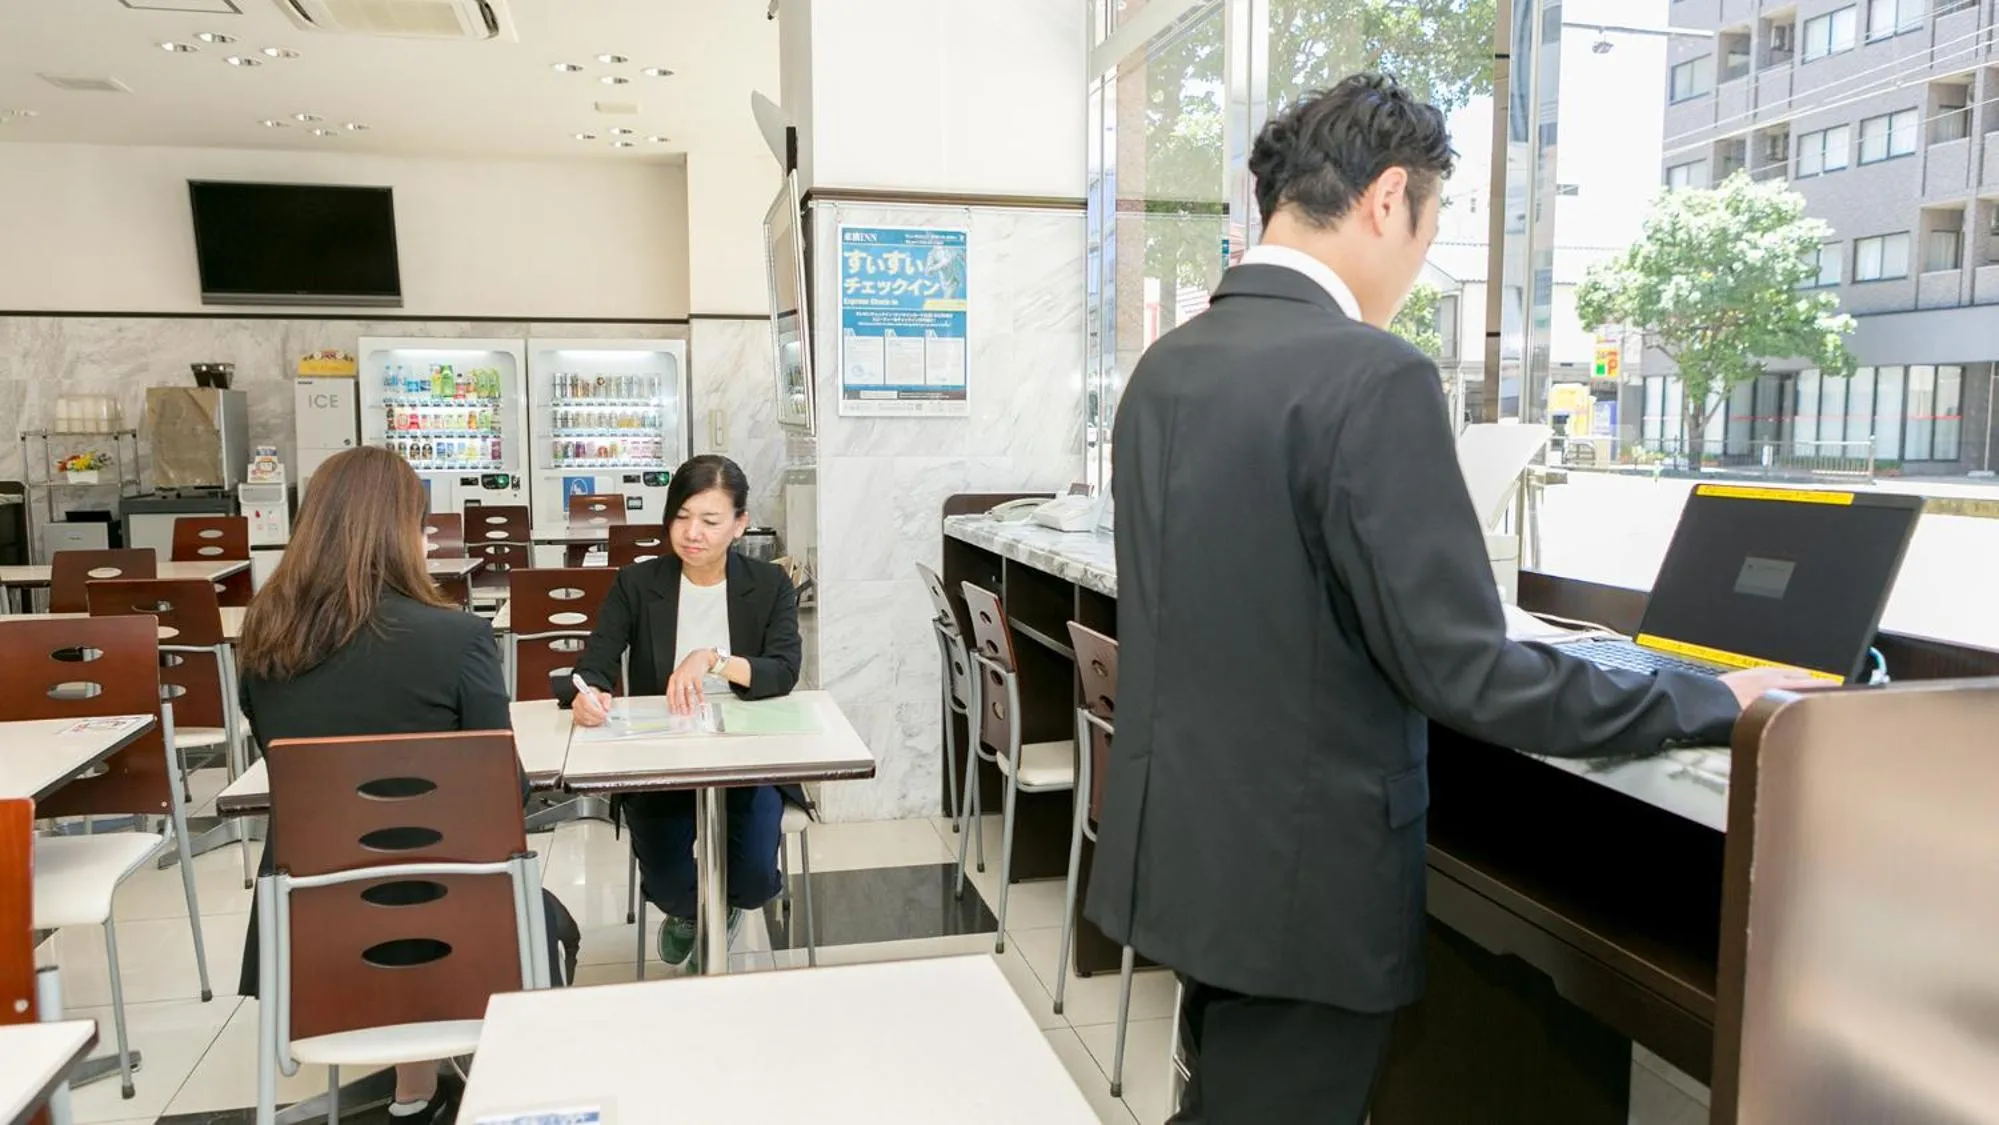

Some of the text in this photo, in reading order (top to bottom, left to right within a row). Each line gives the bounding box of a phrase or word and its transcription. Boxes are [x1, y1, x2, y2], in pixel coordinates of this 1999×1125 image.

[843, 249, 924, 275] すいすい
[843, 276, 940, 296] チェックイン
[308, 394, 339, 409] ICE
